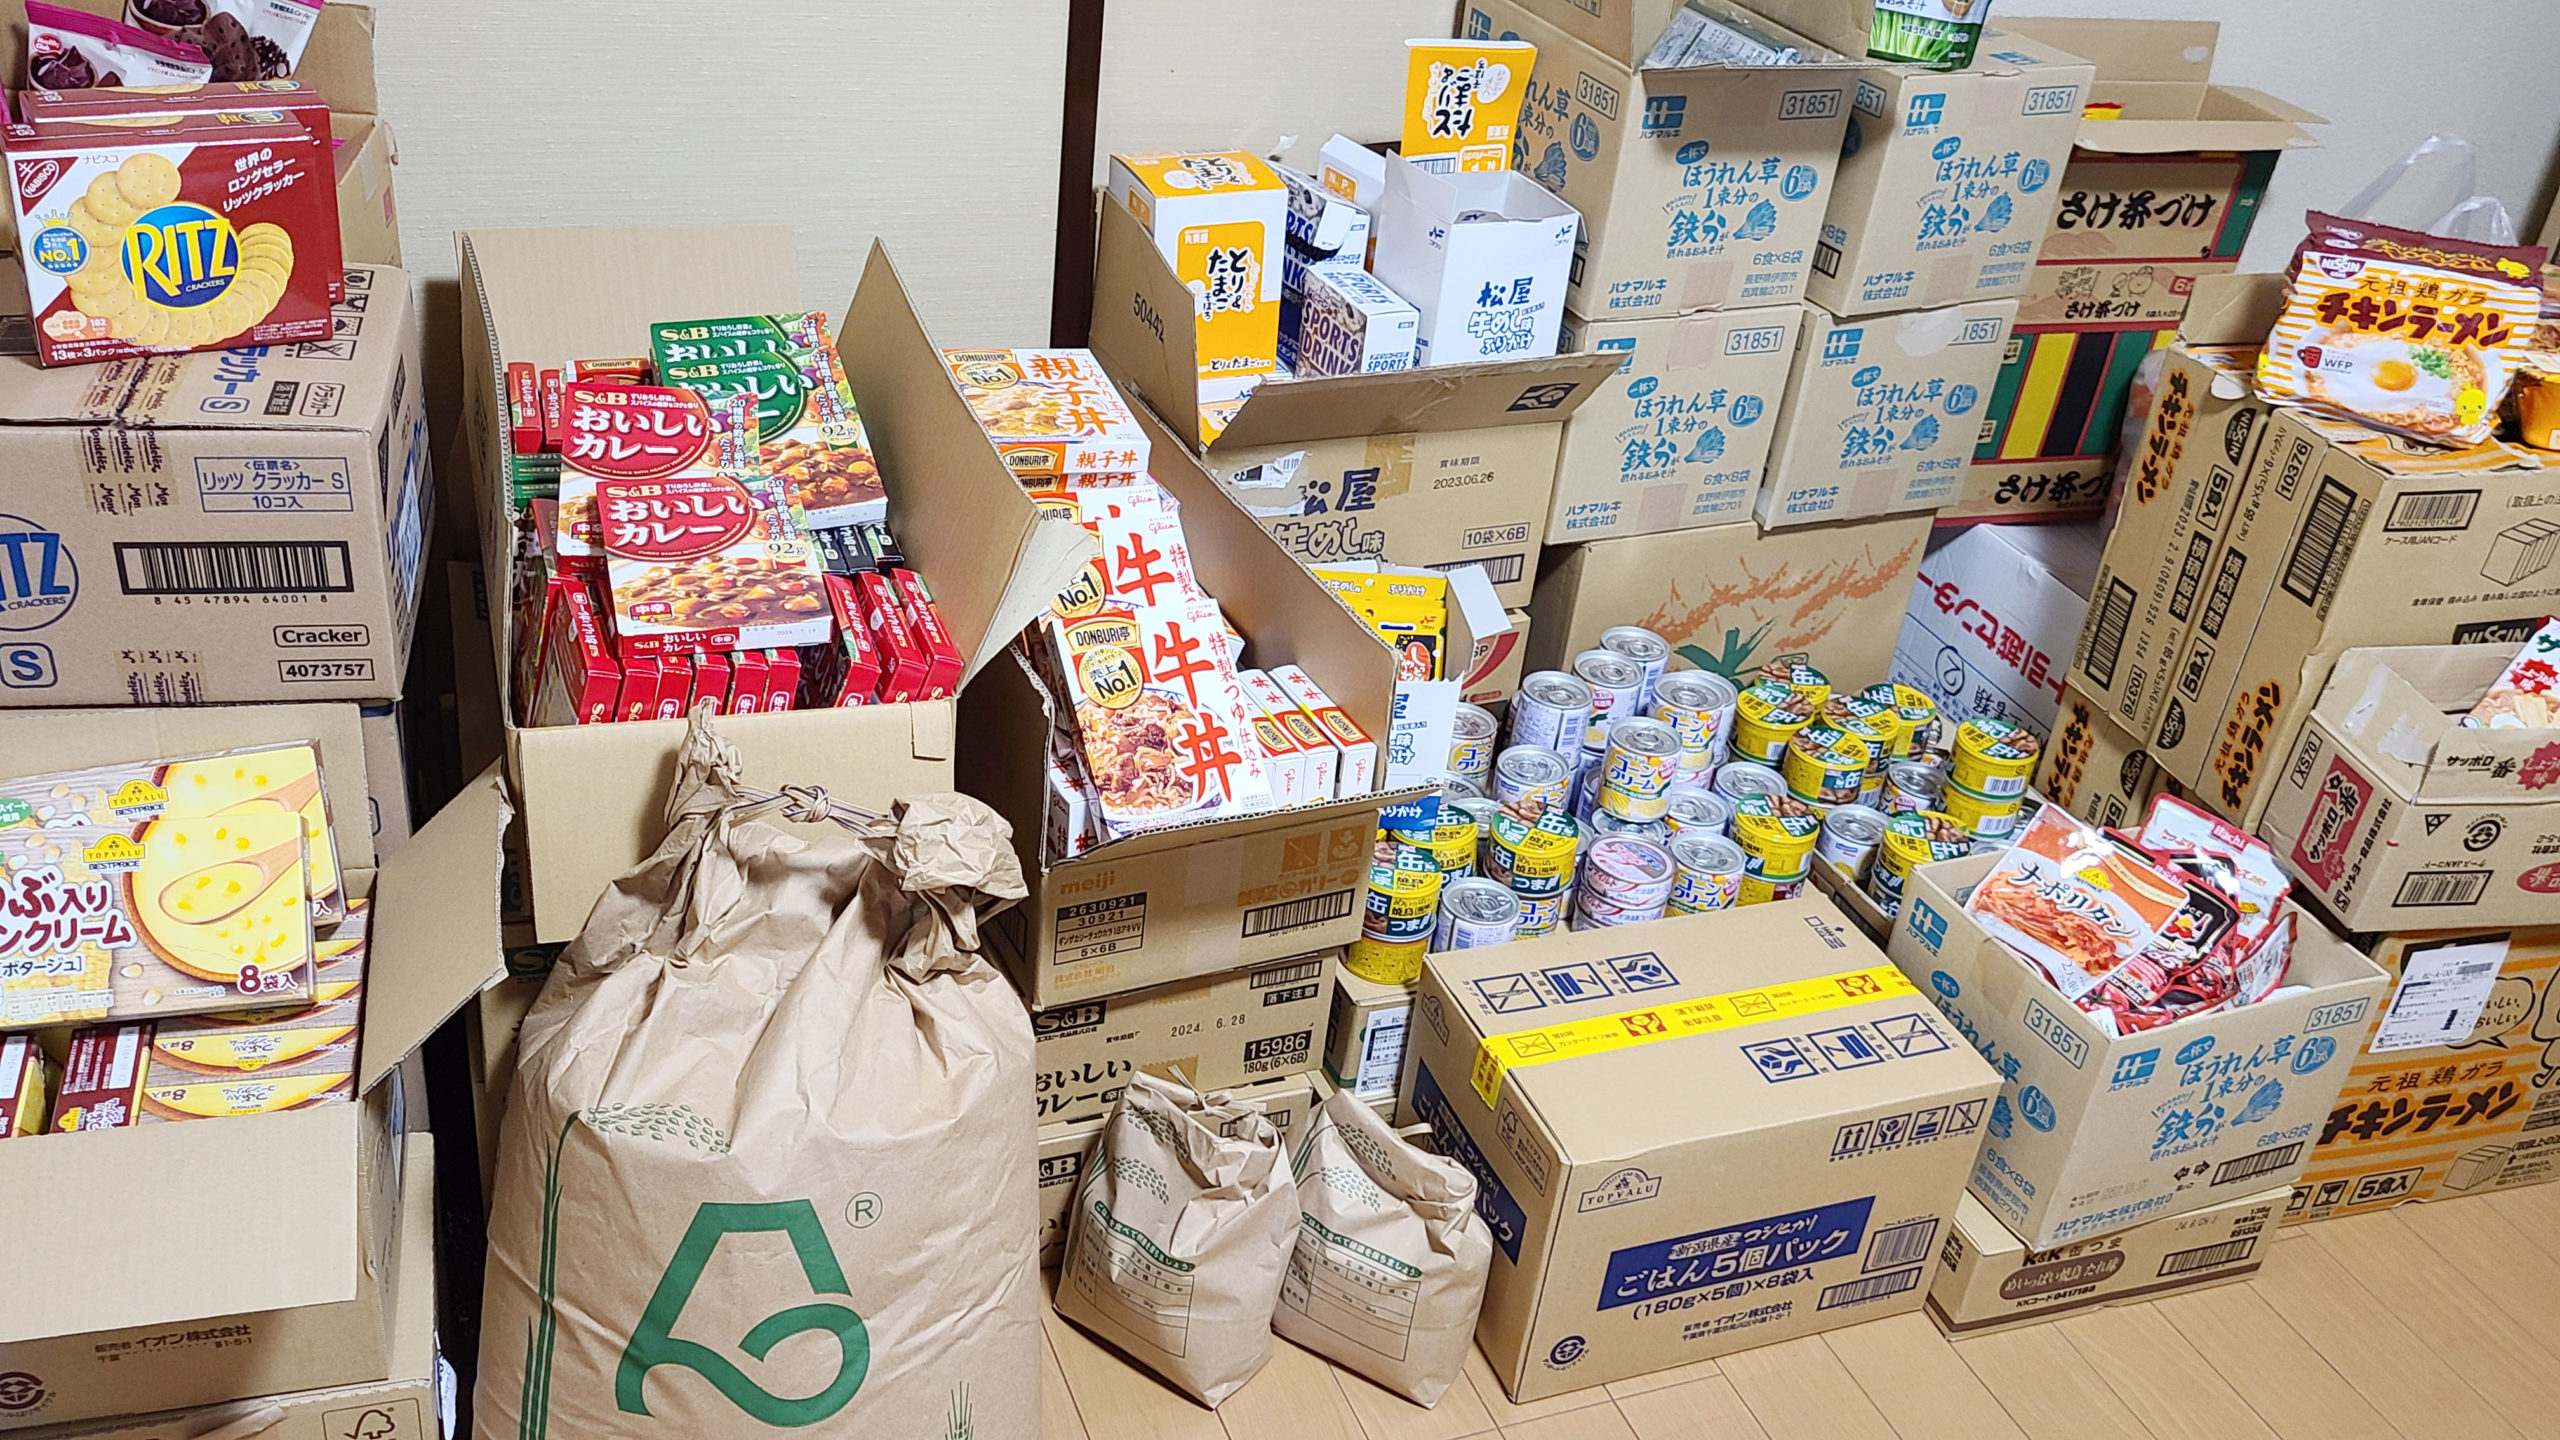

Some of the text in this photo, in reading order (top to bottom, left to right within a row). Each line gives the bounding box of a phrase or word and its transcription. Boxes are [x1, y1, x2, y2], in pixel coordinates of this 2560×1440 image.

[1579, 78, 1618, 114] 31851
[1785, 92, 1837, 116] 31851
[2027, 90, 2073, 112] 31851
[1639, 129, 1681, 140] ハナマルキ
[83, 154, 119, 165] ナビスコ
[235, 148, 272, 173] 世界の
[1936, 151, 2022, 183] ほうれん草
[25, 163, 56, 195] NABISCO
[228, 157, 296, 193] ロングセラー
[1682, 157, 1782, 189] ほうれん草
[222, 170, 305, 213] リッツクラッカー
[1702, 187, 1759, 210] 1束分の
[1950, 179, 2000, 203] 1束分の
[1916, 203, 1971, 241] 鉄分が
[2056, 190, 2216, 231] さけ茶づけ
[1666, 209, 1729, 247] 鉄分が
[126, 219, 238, 302] RITZ
[2321, 256, 2361, 274] NISSIN
[186, 278, 225, 293] CRACKERS
[1608, 278, 1667, 295] ハナマルキ
[1863, 270, 1916, 287] ハナマルキ
[2358, 275, 2489, 305] 元祖鶏ガラ
[1476, 276, 1535, 309] 松屋
[1132, 292, 1166, 345] 50442
[2064, 299, 2142, 320] さけ茶づけ
[2316, 291, 2511, 347] チキンラーメン
[659, 326, 710, 342] S&B
[1303, 301, 1360, 363] SPORTS
[1479, 330, 1536, 355] ふりかけ
[1730, 331, 1780, 351] 31851
[51, 347, 114, 361] 13枚×3パック
[1366, 358, 1409, 373] SPORTS
[1821, 358, 1857, 368] ハナマルキ
[2323, 357, 2354, 371] WFP
[668, 364, 719, 379] S&B
[574, 390, 628, 405] S&B
[631, 393, 676, 402] すりおろし野菜と
[1028, 354, 1121, 437] 親子丼
[1634, 388, 1728, 419] ほうれん草
[1857, 378, 1945, 408] ほうれん草
[572, 405, 723, 437] おいしい
[1653, 415, 1709, 437] 1束分の
[1873, 404, 1925, 425] 1束分の
[822, 425, 858, 438] 92g
[2136, 371, 2189, 505] チキンラーメン
[2228, 409, 2253, 459] NISSIN
[571, 433, 679, 460] カレー
[1620, 437, 1680, 473] 鉄分が
[1009, 454, 1050, 467] DONBURI亭
[1076, 450, 1139, 469] 親子丼
[1439, 455, 1481, 469] 賞味期限
[2278, 442, 2310, 497] 10376
[203, 471, 344, 491] リッツ クラッカー S
[606, 484, 662, 498] S&B
[1432, 471, 1496, 490] 2023.06.26
[252, 495, 303, 509] 10コ入
[1127, 495, 1157, 508] Glico
[1787, 486, 1840, 501] ハナマルキ
[2201, 472, 2229, 521] 5食入
[609, 495, 767, 522] おいしい
[1565, 501, 1622, 517] ハナマルキ
[612, 522, 727, 547] カレー
[1148, 522, 1178, 535] Glico
[1465, 527, 1527, 549] 10袋×6B
[769, 543, 807, 556] 92g
[1114, 531, 1176, 608] 牛
[154, 595, 327, 605] 8 45 47894 64001 8
[1388, 583, 1427, 597] ふりかけ
[8, 596, 66, 611] CRACKERS
[635, 603, 667, 615] 中辛
[1186, 610, 1217, 623] Glico
[282, 629, 363, 644] Cracker
[634, 640, 660, 650] S&B
[663, 632, 708, 644] おいしい
[663, 643, 695, 653] カレー
[714, 635, 733, 644] 中辛
[1075, 626, 1132, 647] DONBURI亭
[9, 650, 43, 681] S
[286, 664, 366, 678] 4073757
[2182, 648, 2211, 695] 5食入
[1095, 659, 1138, 701] No.1
[2121, 665, 2145, 716] 10376
[1152, 621, 1244, 804] 牛丼
[1208, 631, 1263, 780] 特製つゆ仕込み
[1663, 711, 1707, 734] コーン
[2159, 703, 2184, 749] NISSIN
[2221, 680, 2282, 811] チキンラーメン
[1613, 755, 1657, 778] コーン
[2293, 740, 2319, 781] XS70
[2446, 754, 2518, 779] サッポロ一番
[1610, 768, 1656, 791] クリーム
[113, 794, 164, 807] TOPVALU
[116, 803, 165, 816] BESTPRICE
[2308, 773, 2361, 863] サッポロ一番
[2213, 822, 2247, 850] Hachi
[88, 849, 141, 860] TOPVALU
[89, 860, 140, 871] BESTPRICE
[1060, 871, 1116, 895] meiji
[1677, 873, 1716, 896] コーン
[1068, 895, 1136, 918] 2630921
[1673, 885, 1722, 909] クリーム
[2008, 860, 2141, 945] ナポリタン
[1077, 909, 1126, 927] 30921
[1080, 941, 1118, 958] 5×6B
[239, 965, 297, 993] 8袋入
[1265, 986, 1317, 1004] 落下注意
[1034, 1004, 1101, 1032] S&B
[1171, 1021, 1206, 1038] 2024.
[1231, 1013, 1247, 1027] 28
[2309, 1001, 2364, 1029] 31851
[1248, 1033, 1308, 1060] 15986
[2030, 1006, 2085, 1063] 31851
[1243, 1050, 1309, 1075] 180g(6×6B)
[2179, 1034, 2296, 1088] ほうれん草
[1035, 1058, 1133, 1093] おいしい
[2107, 1077, 2152, 1093] ハナマルキ
[2367, 1060, 2504, 1094] 元祖鶏ガラ
[2198, 1073, 2267, 1104] 1束分の
[2315, 1081, 2521, 1146] チキンラーメン
[2151, 1102, 2226, 1151] 鉄分が
[2256, 1122, 2313, 1149] 6食×8袋
[1588, 1184, 1656, 1207] TOPVALU
[2356, 1174, 2408, 1199] 5食入
[1743, 1214, 1820, 1244] コシヒカリ
[1615, 1227, 1852, 1299] ごはん5個パック
[1631, 1268, 1817, 1321] (180g×5個)×8袋入
[1713, 1300, 1794, 1326] イオン株式会社
[136, 1324, 252, 1348] イオン株式会社
